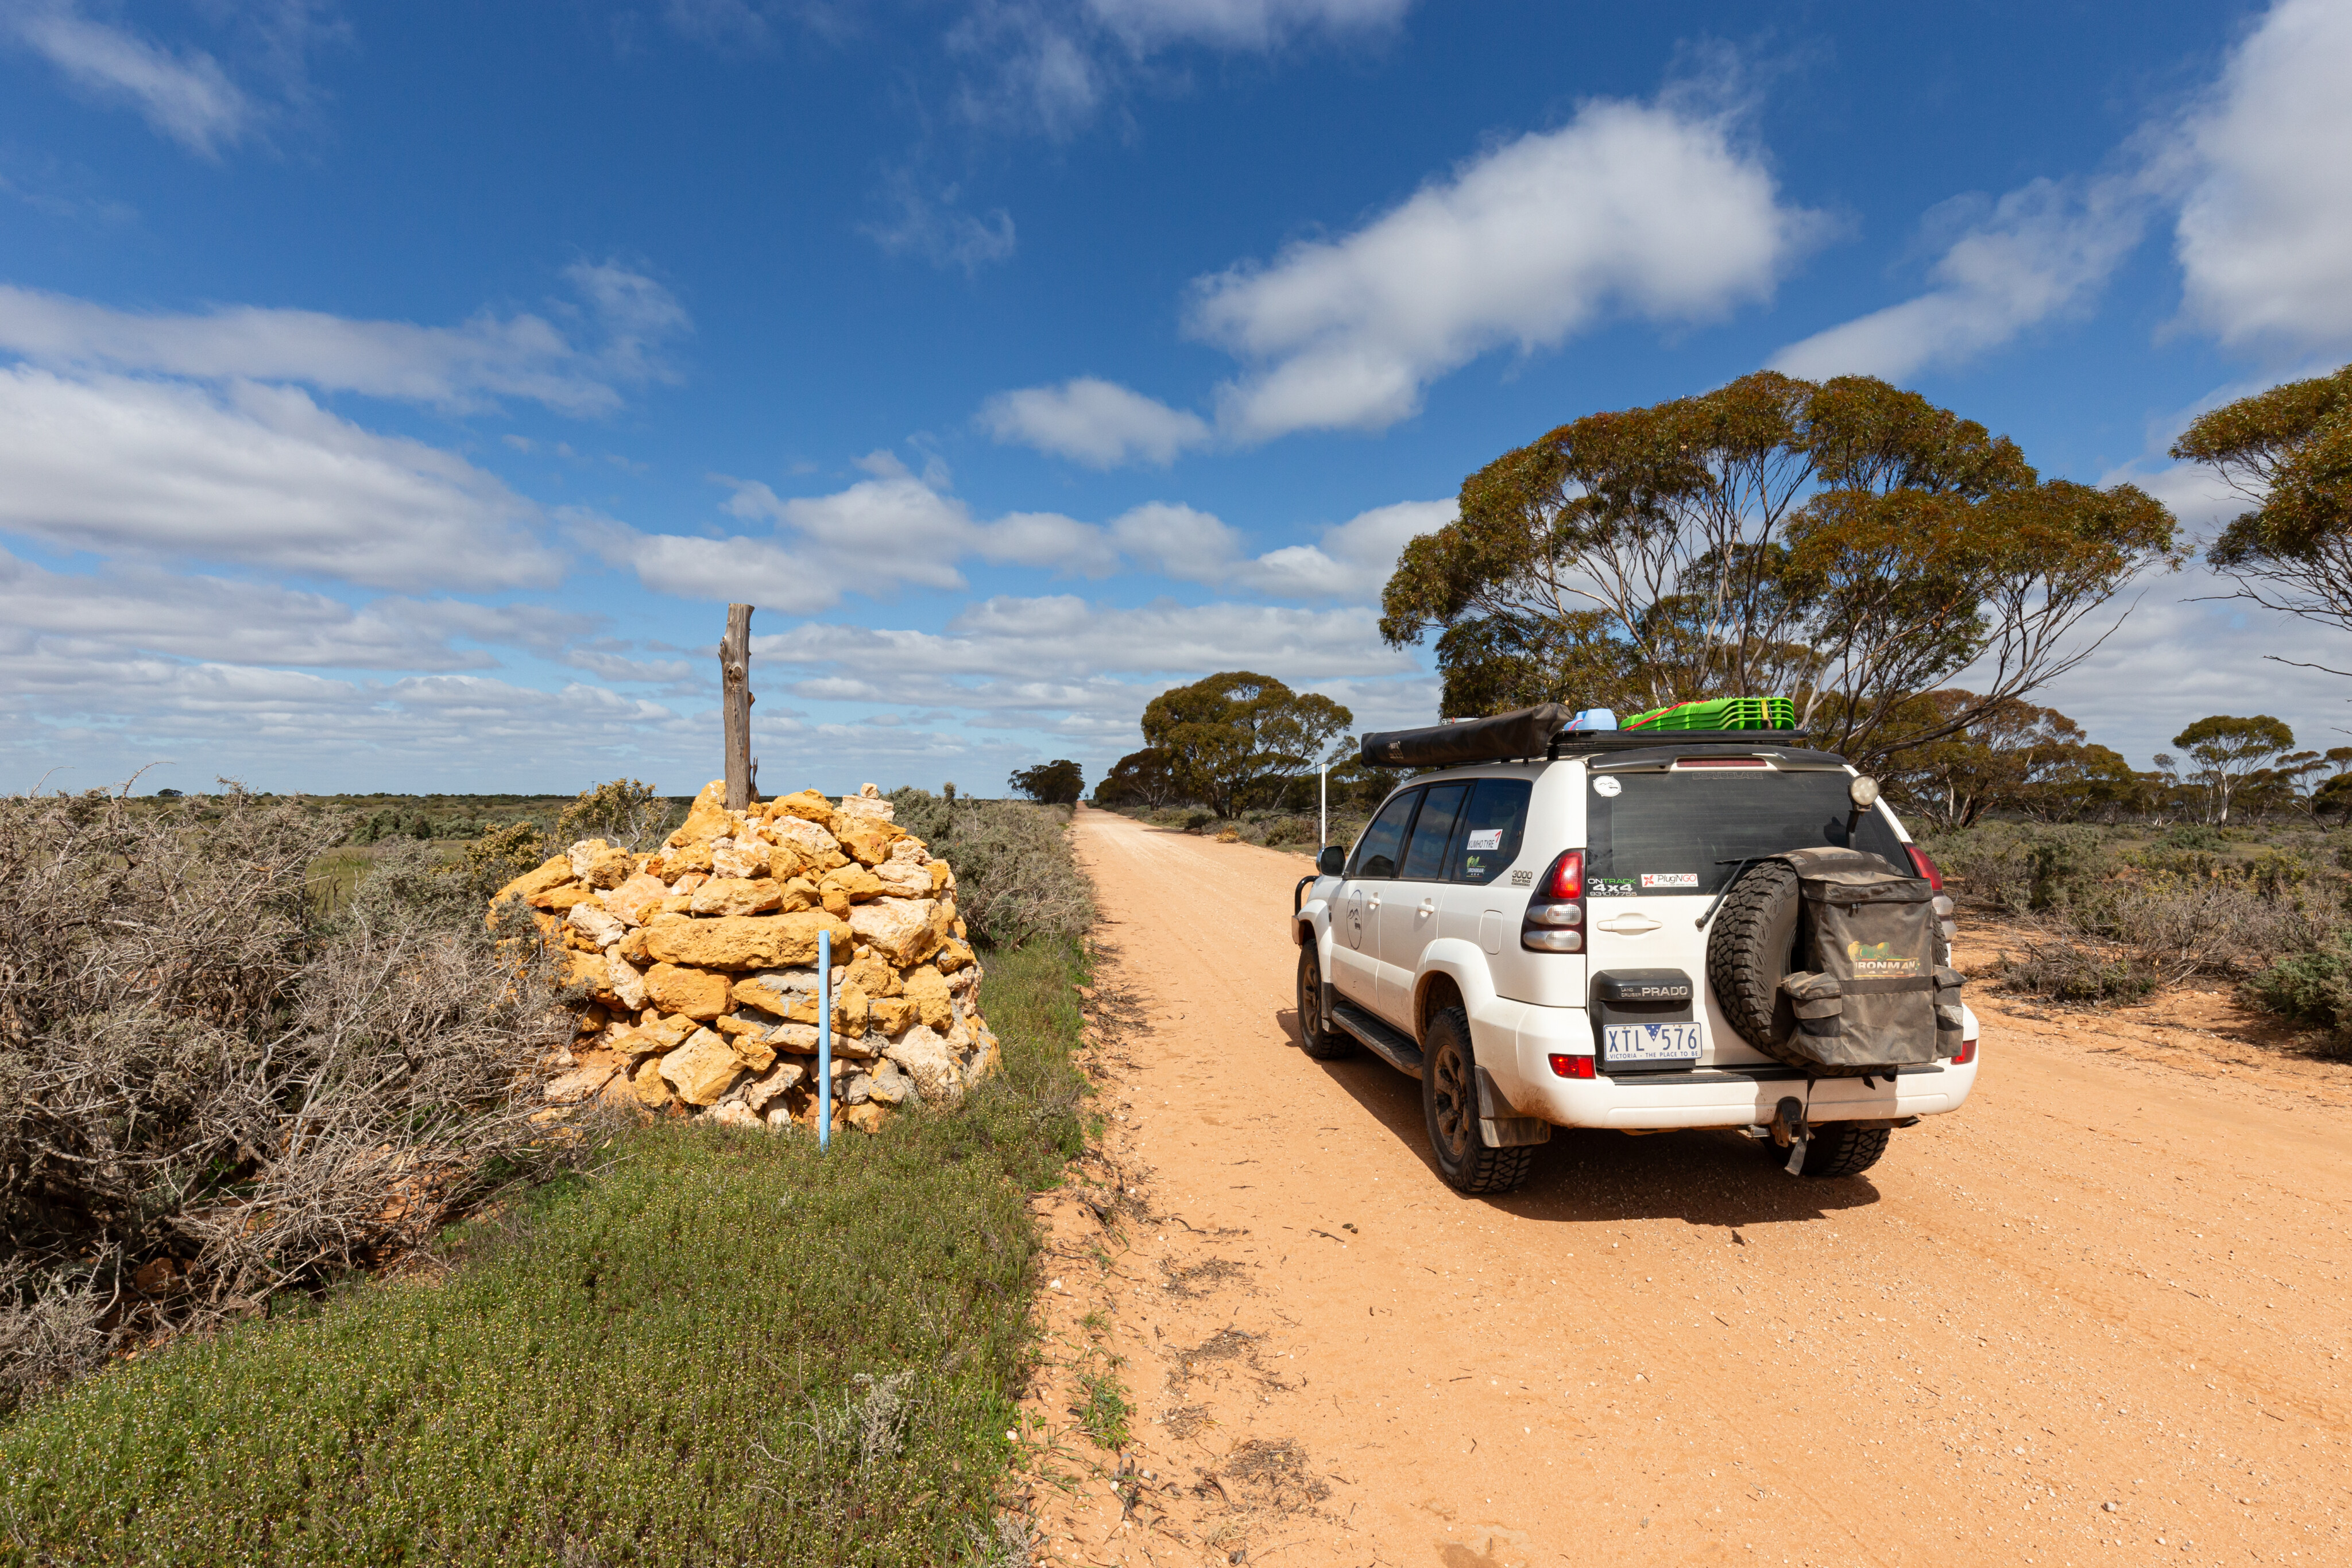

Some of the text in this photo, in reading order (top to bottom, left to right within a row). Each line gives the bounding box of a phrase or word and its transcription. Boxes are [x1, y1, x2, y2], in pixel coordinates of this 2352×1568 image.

[1692, 772, 1763, 780] SCRUBBLADE
[1468, 840, 1495, 848] KUMHO TYRE
[1512, 870, 1533, 879] 3000
[1855, 961, 1916, 970] IRONMAN
[1642, 986, 1688, 997] PRADO
[1608, 1028, 1697, 1052] XTL 576
